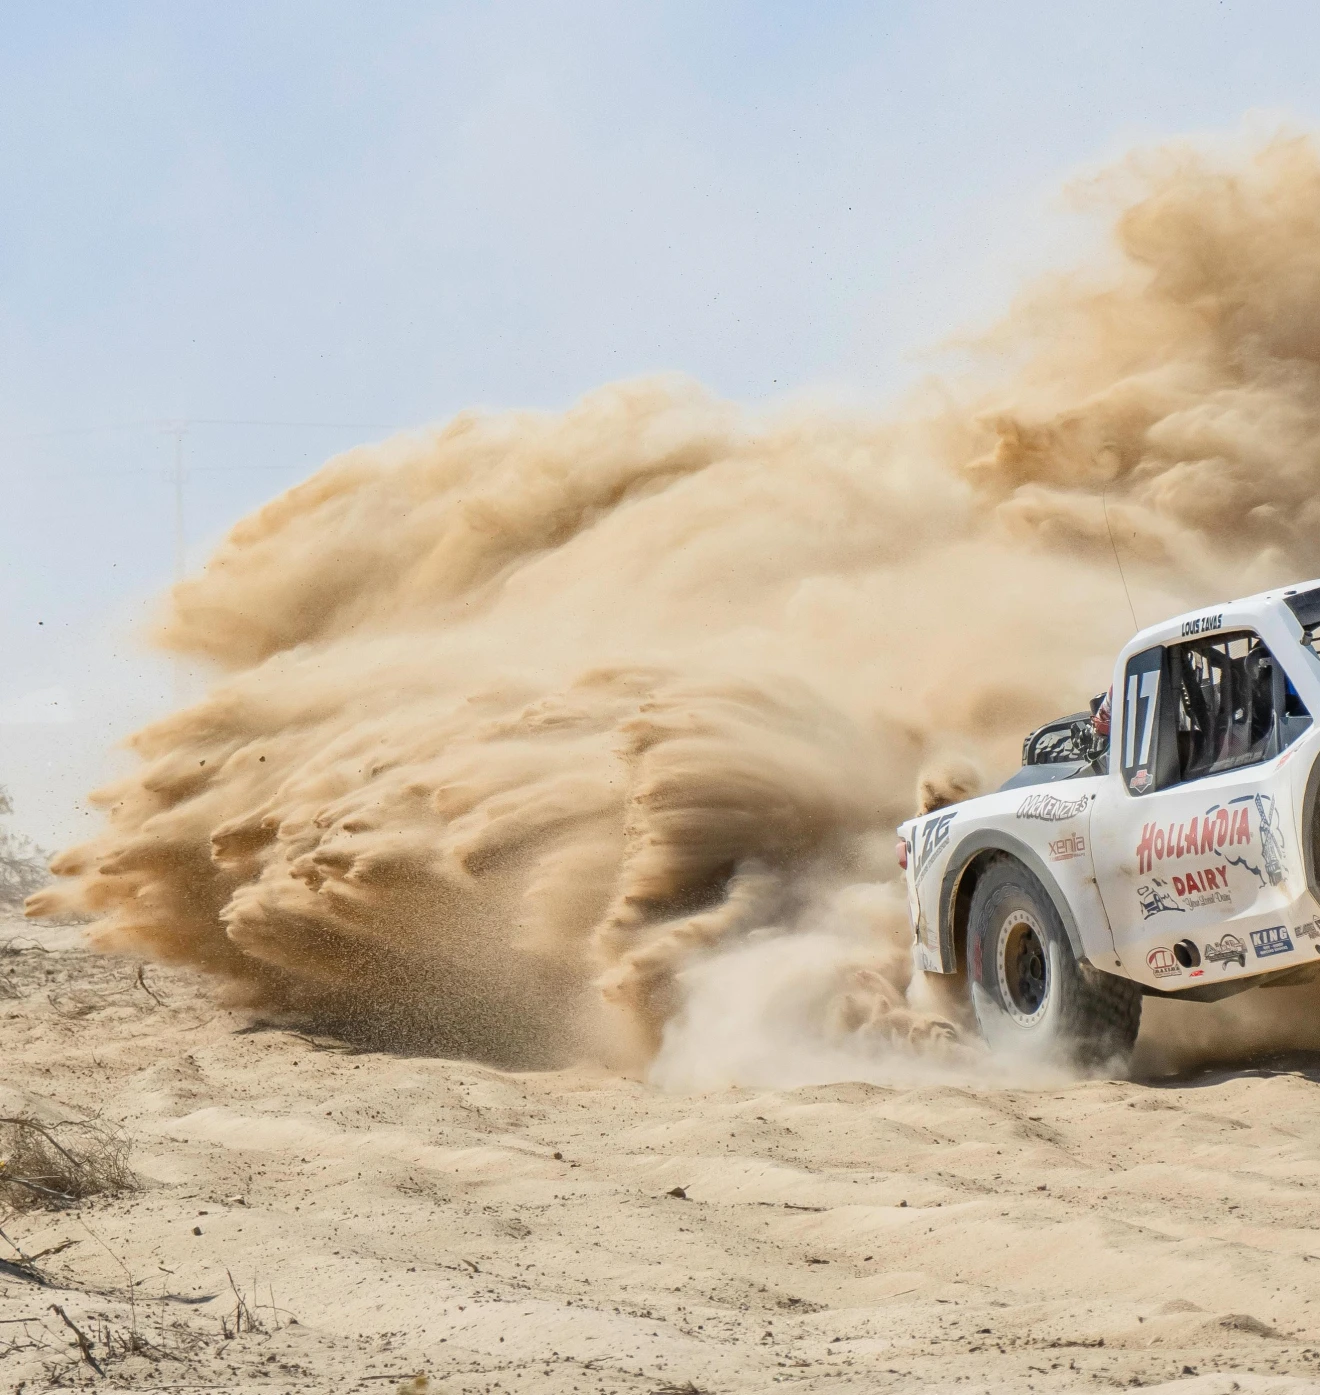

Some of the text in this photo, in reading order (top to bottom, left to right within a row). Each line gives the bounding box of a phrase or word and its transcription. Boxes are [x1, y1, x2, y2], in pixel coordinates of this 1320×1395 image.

[1181, 613, 1223, 637] LOUIS ZAVAS
[1125, 670, 1161, 769] 17
[1049, 832, 1086, 856] xenia
[1136, 807, 1250, 875] HOLLANDIA
[1172, 865, 1229, 897] DAIRY
[1252, 927, 1288, 945] KING
